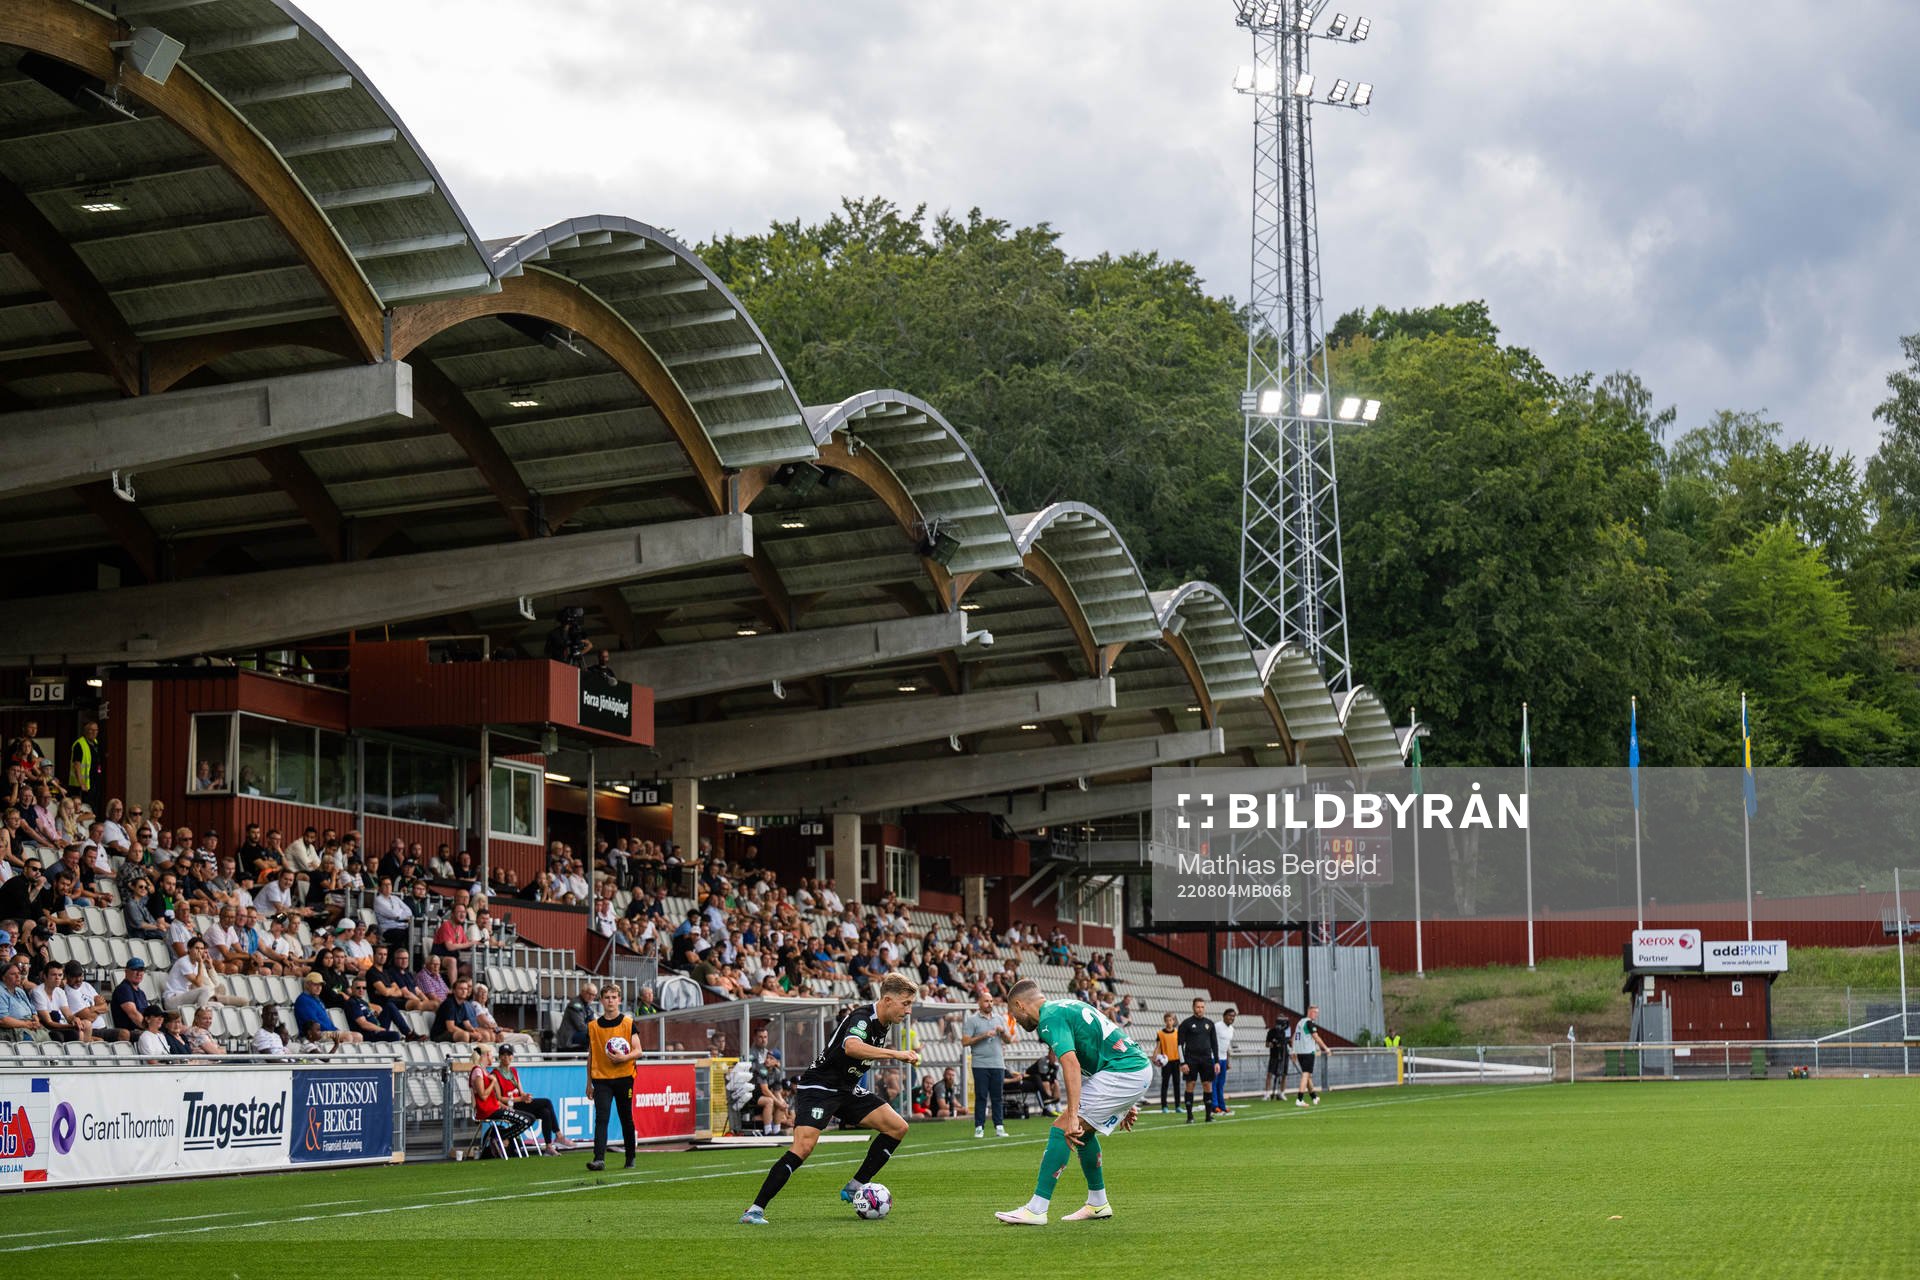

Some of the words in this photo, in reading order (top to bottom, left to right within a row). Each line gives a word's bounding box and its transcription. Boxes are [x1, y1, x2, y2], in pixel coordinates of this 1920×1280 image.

[33, 688, 42, 698] D
[52, 687, 60, 698] C
[583, 690, 600, 707] Forza
[1639, 937, 1674, 946] xerox
[1733, 983, 1742, 993] 6
[306, 1081, 378, 1106] ANDERSSON
[183, 1091, 286, 1149] Tingstad
[305, 1107, 321, 1151] &
[323, 1109, 362, 1133] BERGH
